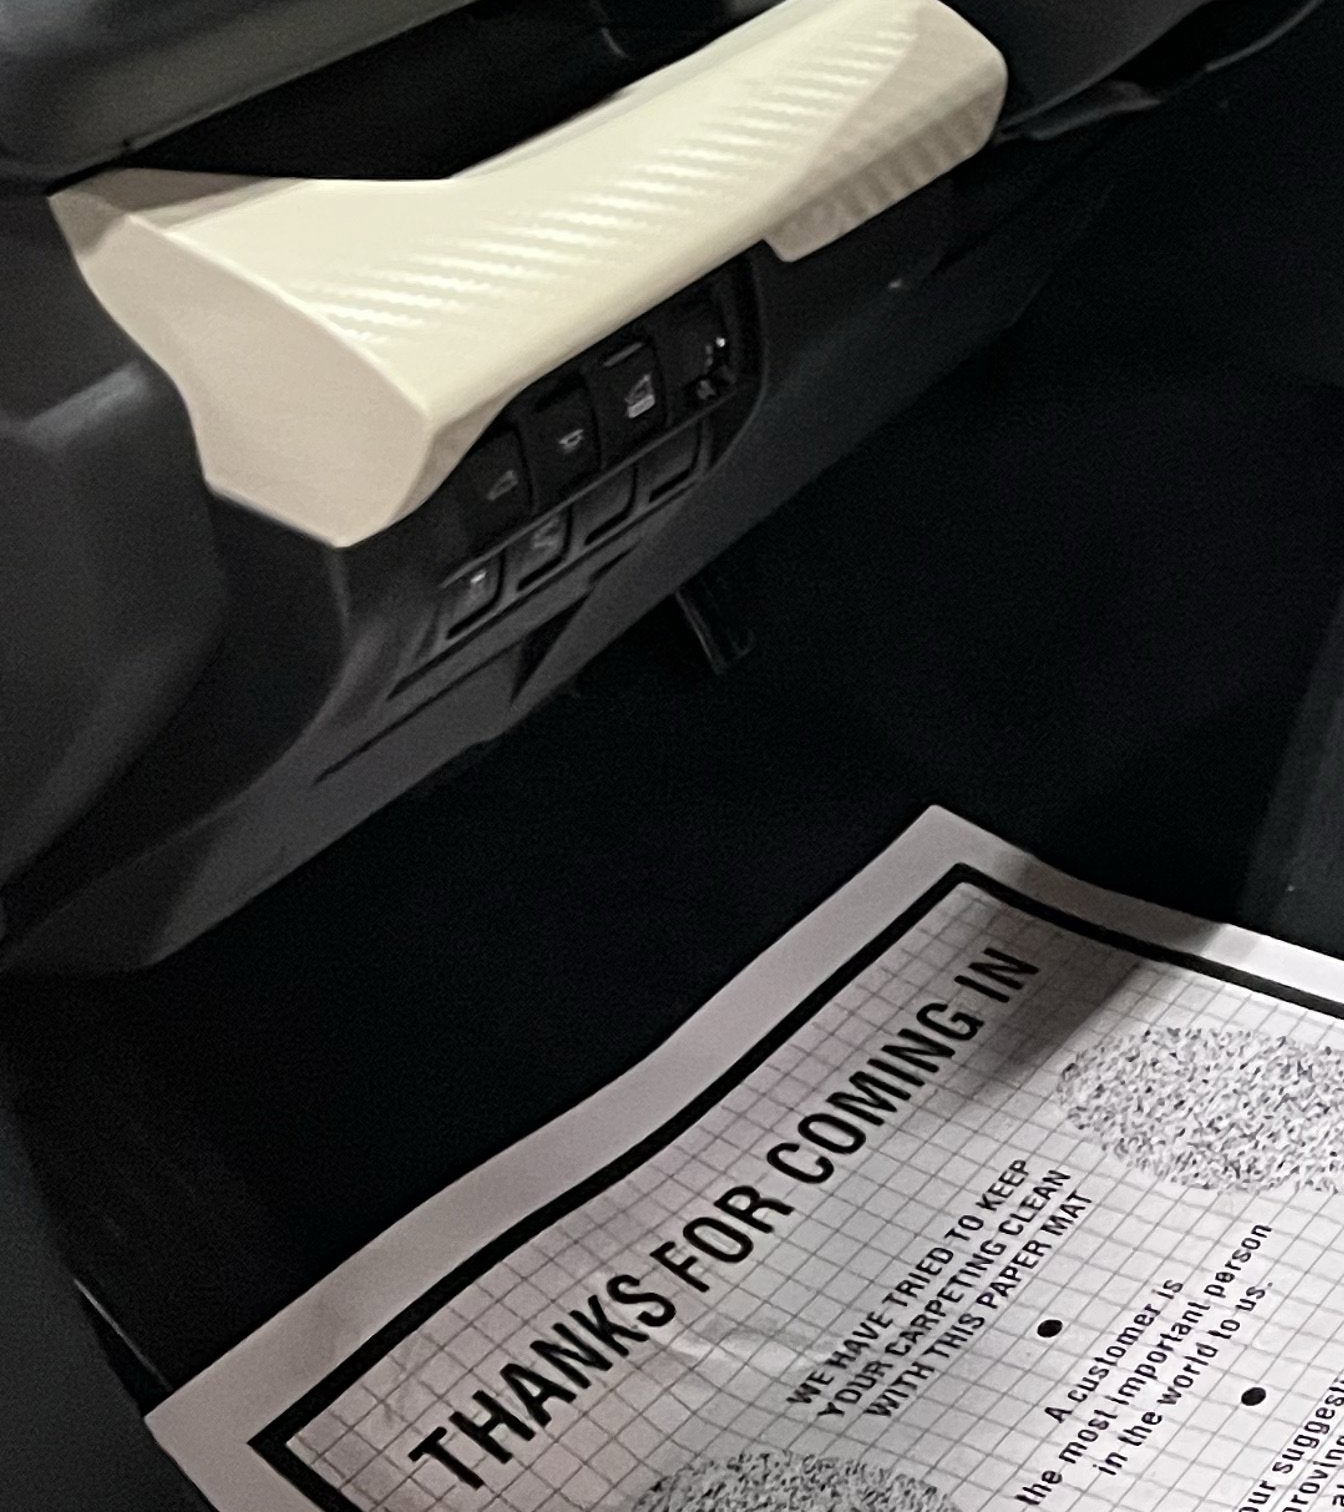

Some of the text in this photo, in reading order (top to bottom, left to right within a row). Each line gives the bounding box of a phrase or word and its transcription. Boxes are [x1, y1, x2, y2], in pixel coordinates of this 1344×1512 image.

[408, 947, 1039, 1490] THANKS FOR COMING IN
[786, 1159, 1029, 1405] WE HAVE TRIED TO KEEP
[817, 1169, 1071, 1418] YOUR CARPETING CLEAN
[865, 1190, 1092, 1417] WITH THIS PAPER MAT
[1014, 1223, 1273, 1506] the most important person
[1044, 1277, 1184, 1424] A customer is
[1092, 1281, 1274, 1476] in the world to us.
